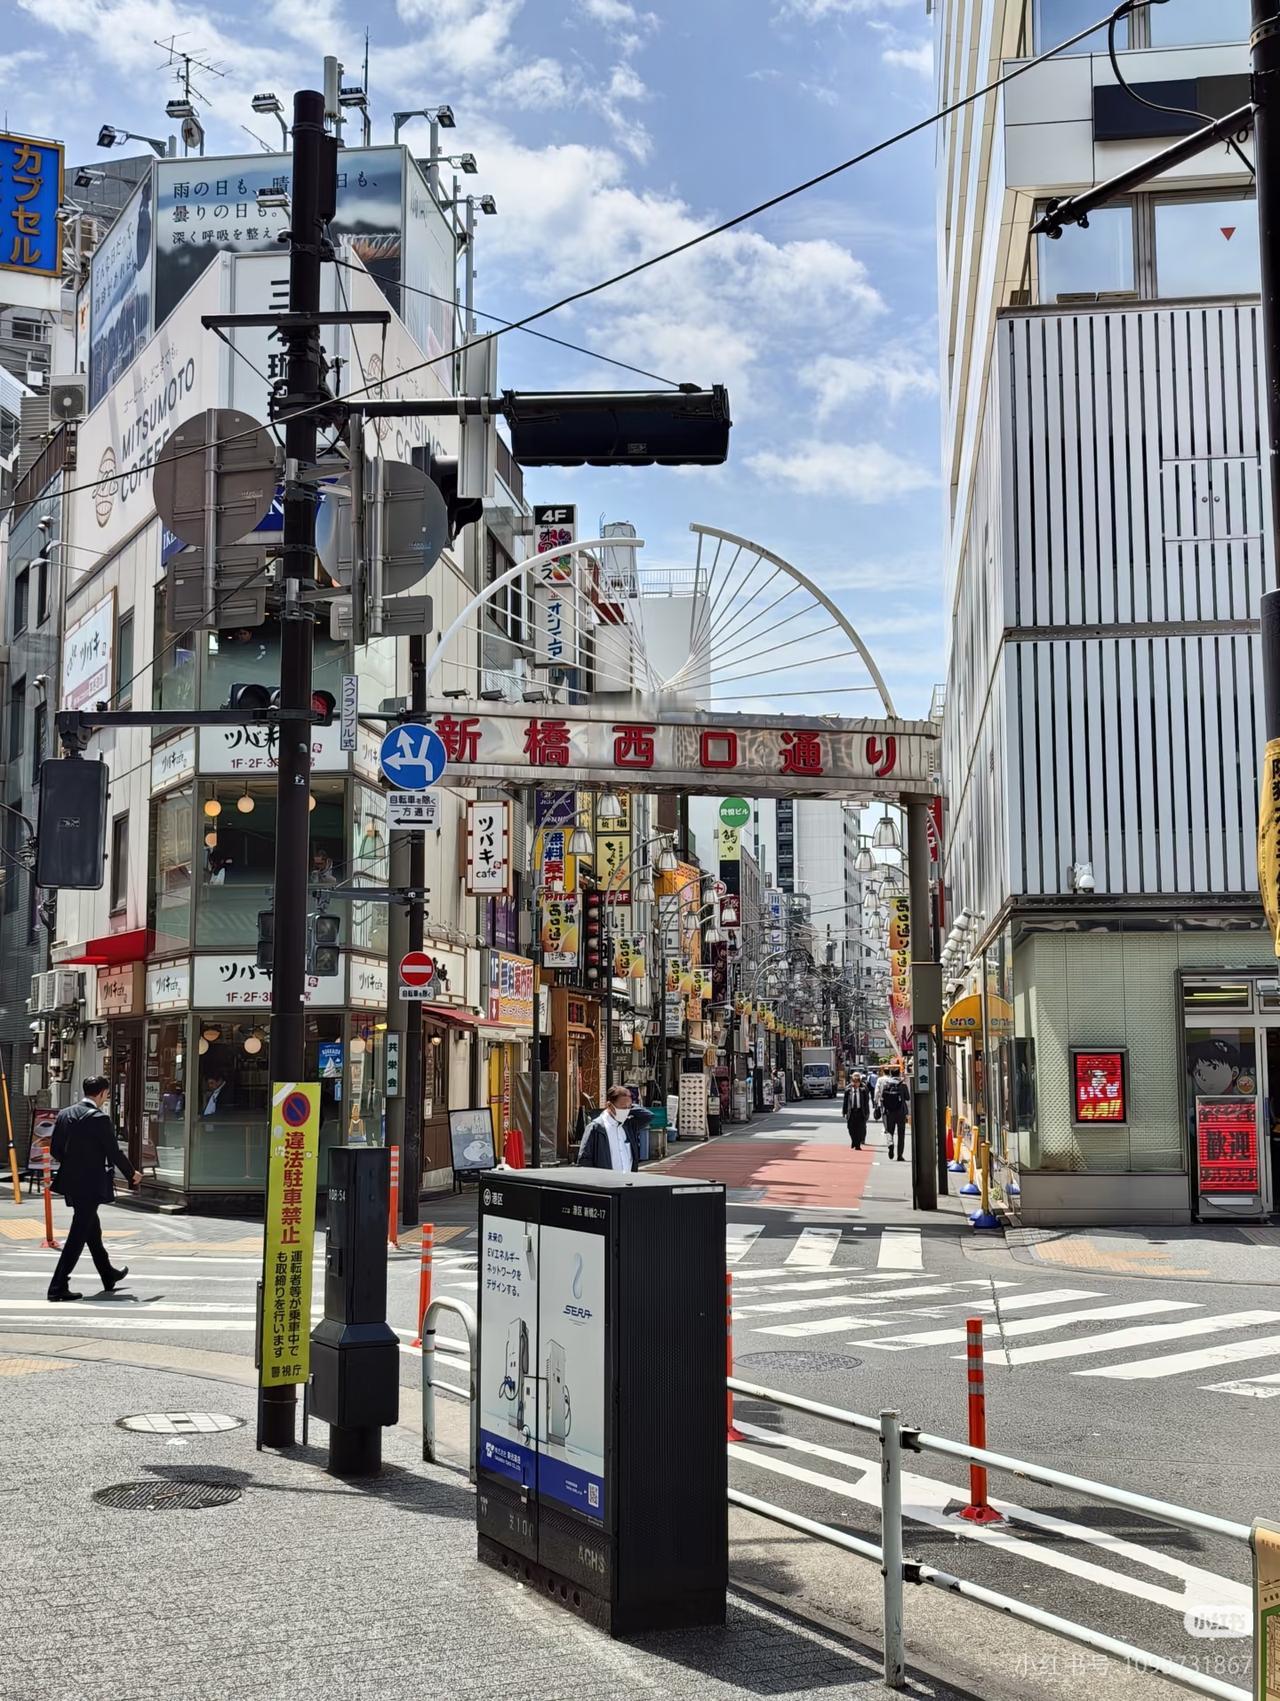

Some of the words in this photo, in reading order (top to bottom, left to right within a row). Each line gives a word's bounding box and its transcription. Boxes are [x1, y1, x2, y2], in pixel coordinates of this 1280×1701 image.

[10, 144, 42, 265] カプセル
[172, 227, 289, 245] 深く呼吸を整え
[121, 357, 195, 463] MITSUMOTO
[542, 509, 567, 522] 4F
[435, 716, 897, 780] 新橋西口通り
[391, 808, 435, 817] 一方通行
[478, 816, 495, 866] ツバキ
[476, 868, 497, 879] cafe
[281, 1131, 305, 1245] 違法駐車禁止
[486, 1263, 522, 1282] ネットワークを
[273, 1252, 288, 1359] も取締りを行います
[288, 1250, 303, 1357] 運転者等が乗車中で
[271, 1364, 302, 1378] 警視庁
